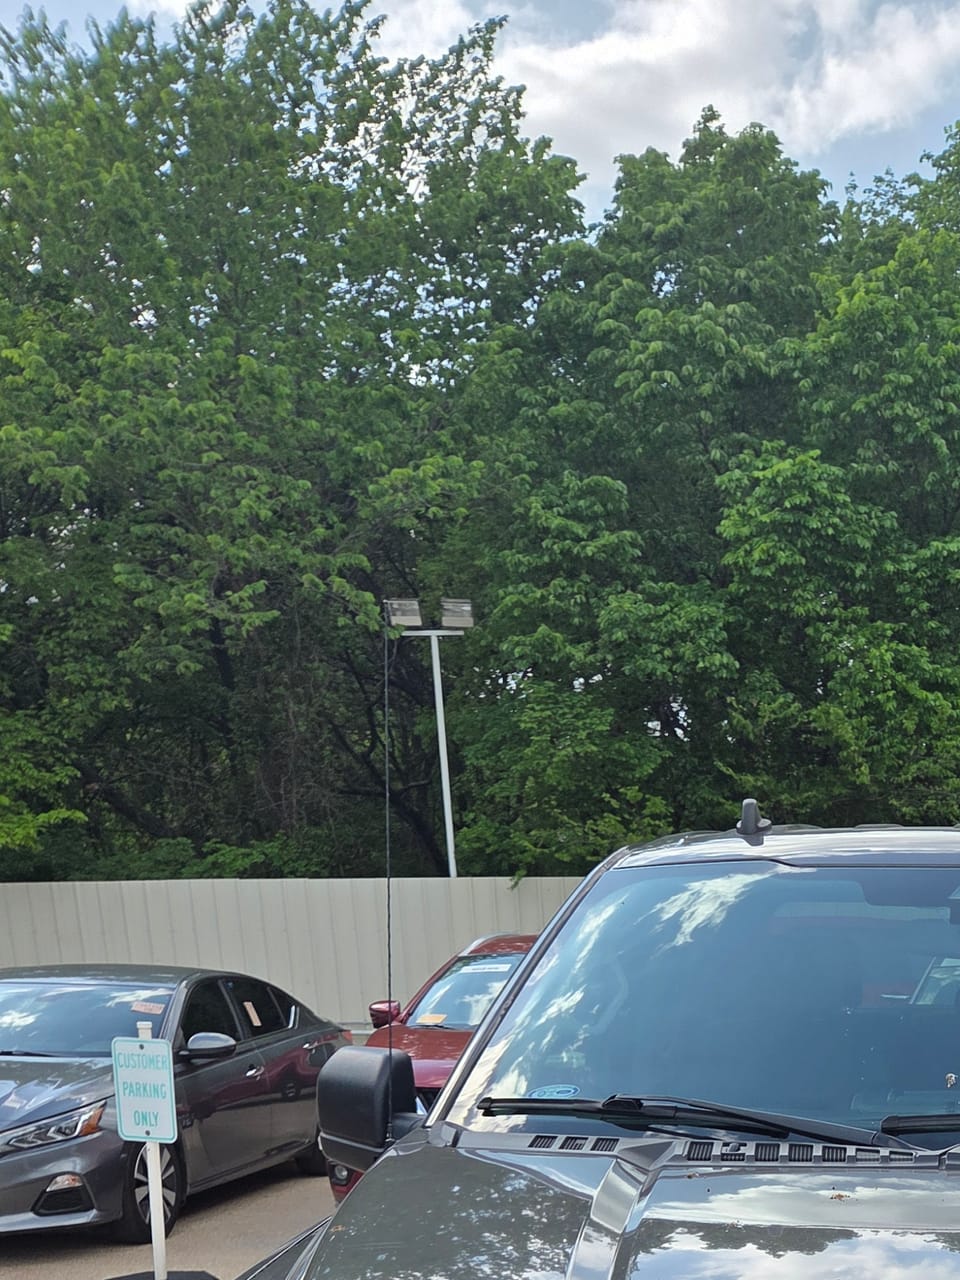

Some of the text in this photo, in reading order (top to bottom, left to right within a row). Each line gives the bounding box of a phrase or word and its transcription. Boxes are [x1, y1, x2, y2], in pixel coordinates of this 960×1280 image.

[117, 1053, 169, 1070] CUSTOMER
[122, 1081, 167, 1099] PARKING
[133, 1110, 159, 1128] ONLY
